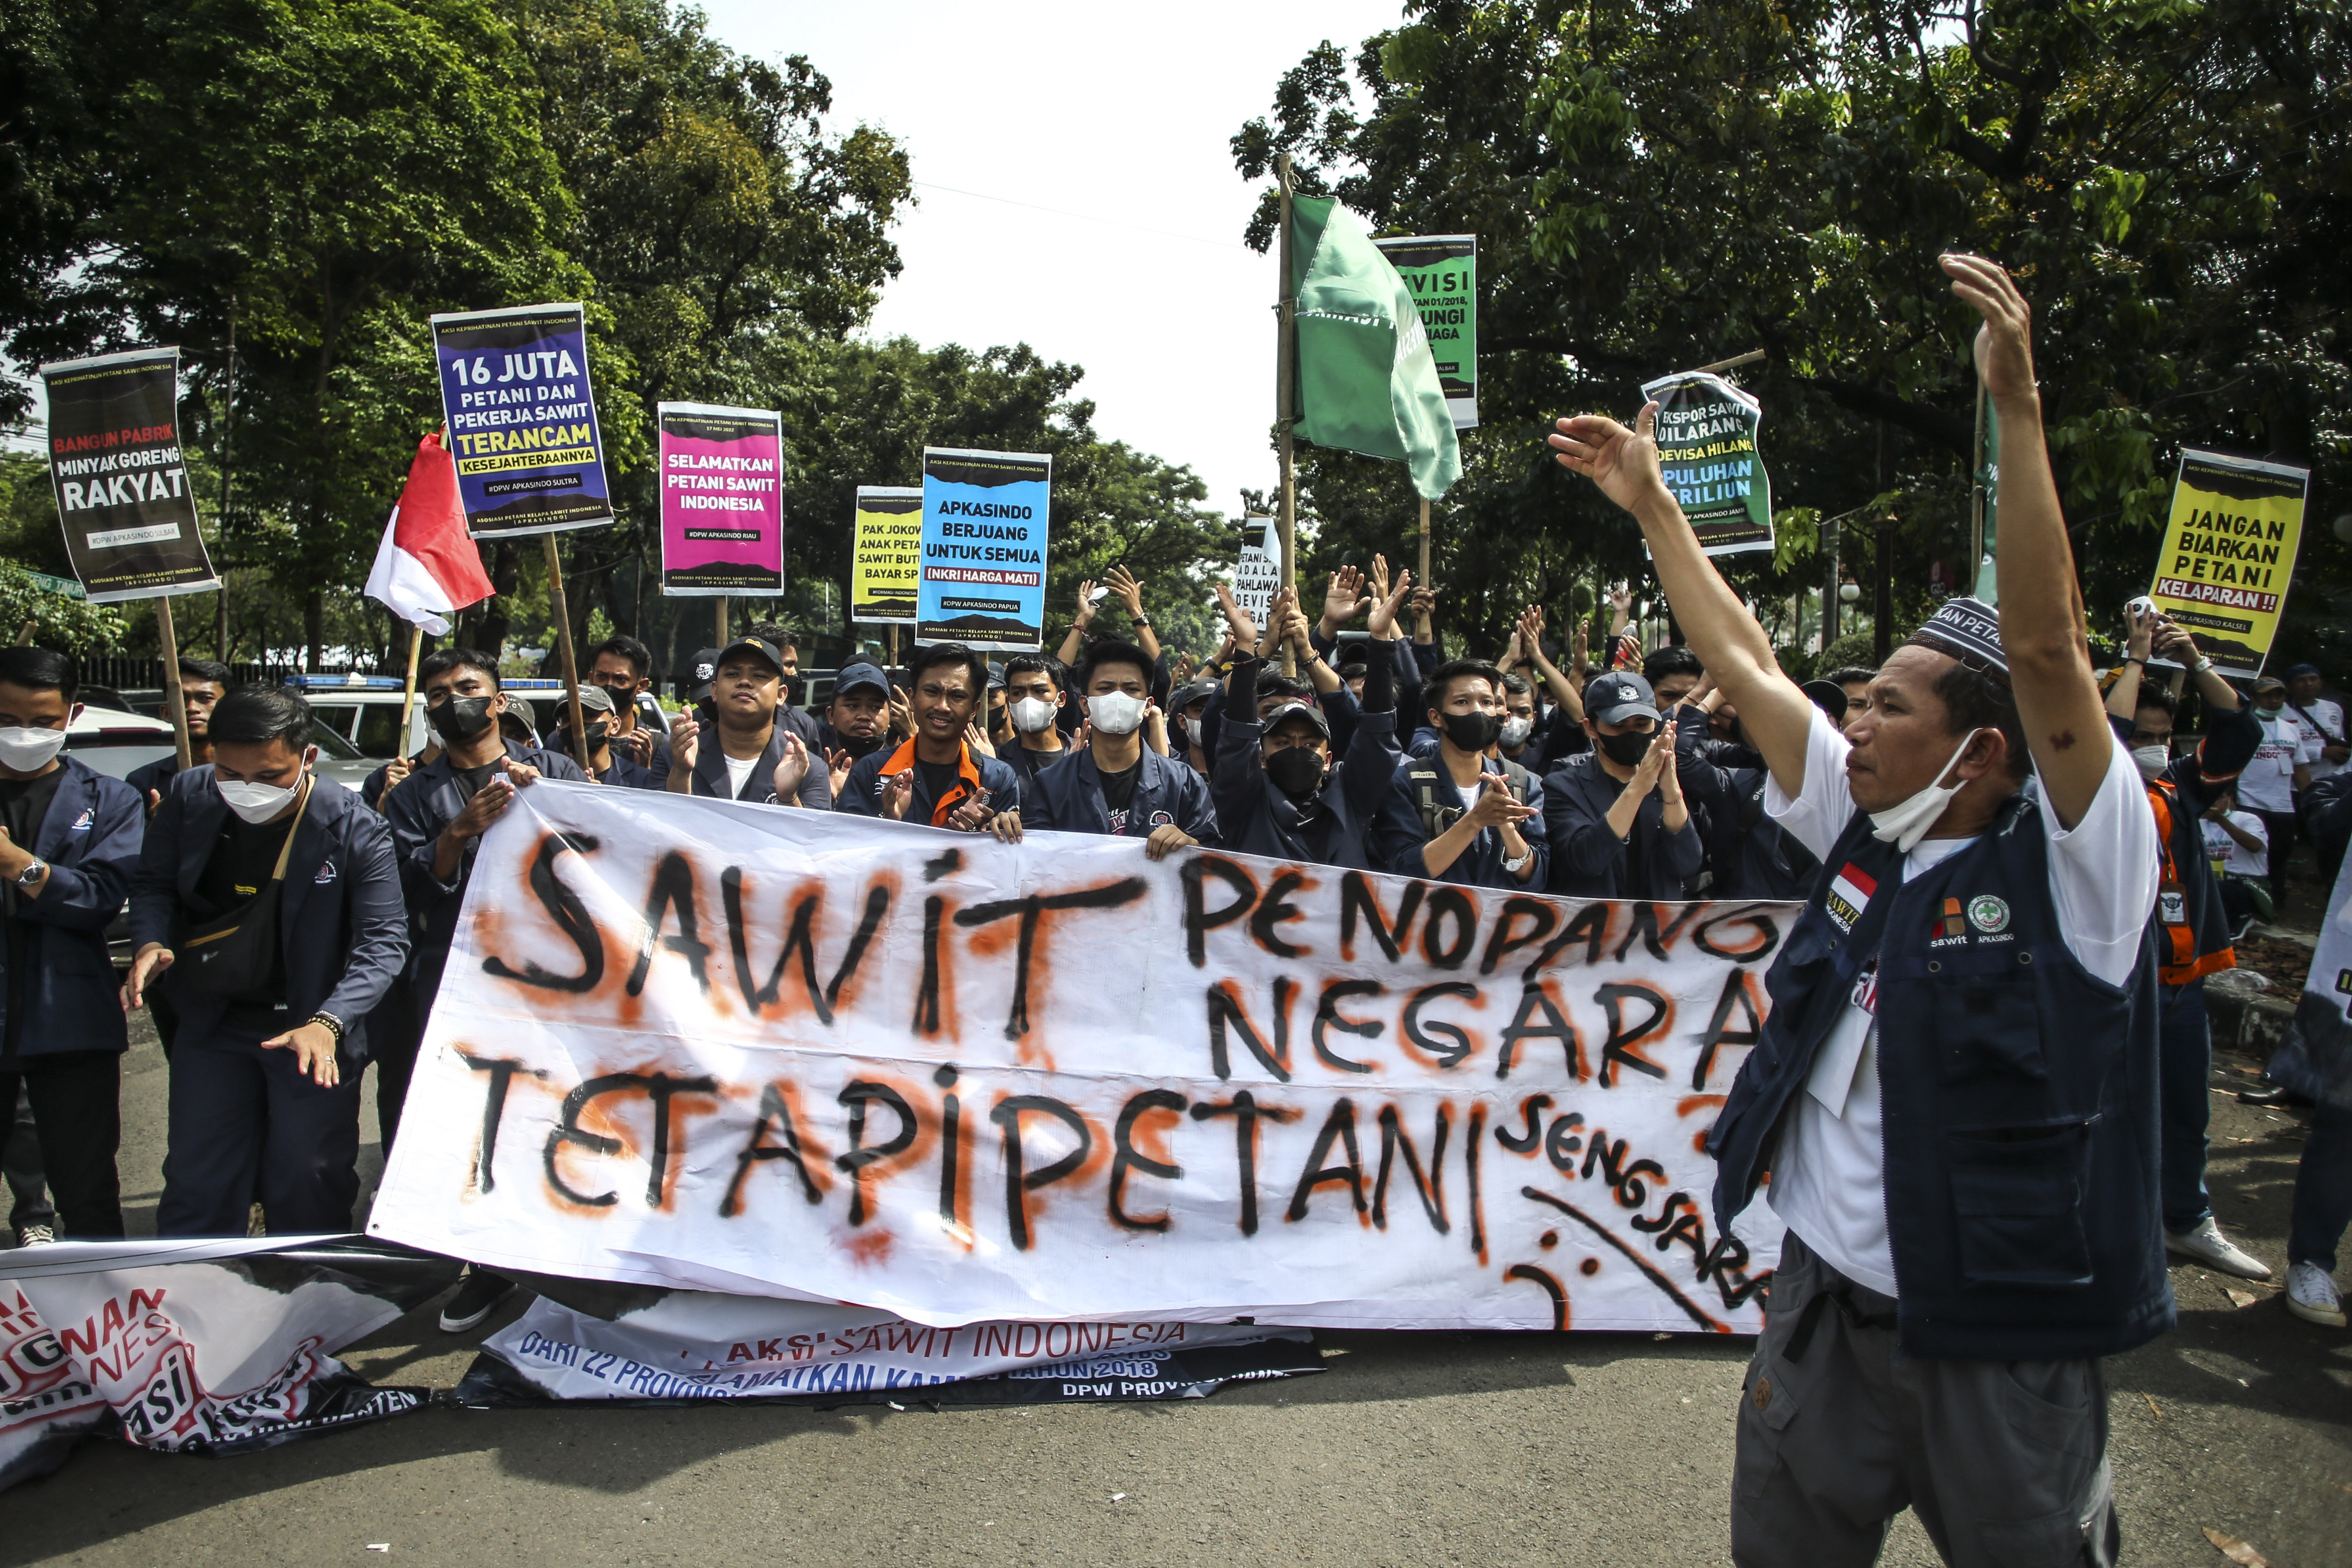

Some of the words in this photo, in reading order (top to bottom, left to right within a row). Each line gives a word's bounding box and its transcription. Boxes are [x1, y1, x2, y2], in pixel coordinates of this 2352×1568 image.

[1419, 308, 1465, 326] UNGI
[456, 323, 500, 332] KEPRIHATINAN
[452, 357, 491, 386] 16
[497, 350, 579, 383] JUTA
[461, 387, 531, 408] PETANI
[537, 384, 576, 401] DAN
[453, 407, 535, 429] PEKERJA
[535, 402, 588, 421] SAWIT
[1663, 407, 1707, 424] EKSPOR
[1708, 402, 1748, 417] SAWIT
[54, 430, 118, 453] BANGUN
[122, 423, 175, 447] PABRIK
[456, 423, 592, 455] TERANCAM
[1658, 417, 1748, 442] DILARANG,
[1658, 447, 1706, 462] DEVISA
[1707, 439, 1753, 457] HILANG
[57, 455, 118, 477] MINYAK
[119, 446, 180, 469] GORENG
[463, 450, 594, 473] KESEJAHTERAANNYA
[668, 454, 773, 472] SELAMATKAN
[1663, 460, 1753, 485] PULUHAN
[62, 468, 184, 511] RAKYAT
[489, 485, 510, 493] #DPW
[512, 479, 551, 490] APKASINDO
[553, 477, 578, 486] SULTRA
[668, 475, 724, 489] PETANI
[726, 477, 775, 492] SAWIT
[569, 505, 602, 514] INDONESIA
[680, 495, 765, 512] INDONESIA
[939, 500, 1032, 520] APKASINDO
[1693, 510, 1728, 519] APKASINDO
[1729, 507, 1745, 515] JAMBI
[862, 525, 884, 535] PAK
[942, 522, 1028, 541] BERJUANG
[2183, 508, 2285, 541] JANGAN
[92, 535, 111, 544] #DPW
[113, 531, 154, 542] APKASINDO
[859, 539, 893, 550] ANAK
[926, 543, 983, 561] UNTUK
[984, 546, 1041, 564] SEMUA
[2178, 531, 2280, 565] BIARKAN
[858, 554, 893, 564] SAWIT
[896, 555, 920, 564] BUT
[1239, 553, 1262, 563] PETANI
[865, 569, 902, 579] BAYAR
[927, 567, 961, 581] (NKRI
[962, 568, 1003, 583] HARGA
[1005, 571, 1037, 586] MATI)
[2173, 555, 2272, 588] PETANI
[2158, 578, 2260, 608] KELAPARAN
[2262, 594, 2277, 611] !!
[2188, 616, 2221, 627] APKASINDO
[2222, 622, 2247, 631] KALSEL
[2224, 654, 2254, 663] INDONESIA
[1827, 890, 1861, 925] SAWIT
[481, 829, 1148, 1044] SAWIT
[1931, 935, 1968, 948] sawit
[1978, 933, 2014, 944] APKASINDO
[450, 1060, 972, 1247] TETAPI
[989, 1088, 1489, 1266] PETANI
[830, 1327, 963, 1359] SAWIT
[972, 1321, 1186, 1358] INDONESIA
[1096, 1361, 1157, 1378] 2018
[1063, 1382, 1113, 1397] DPW
